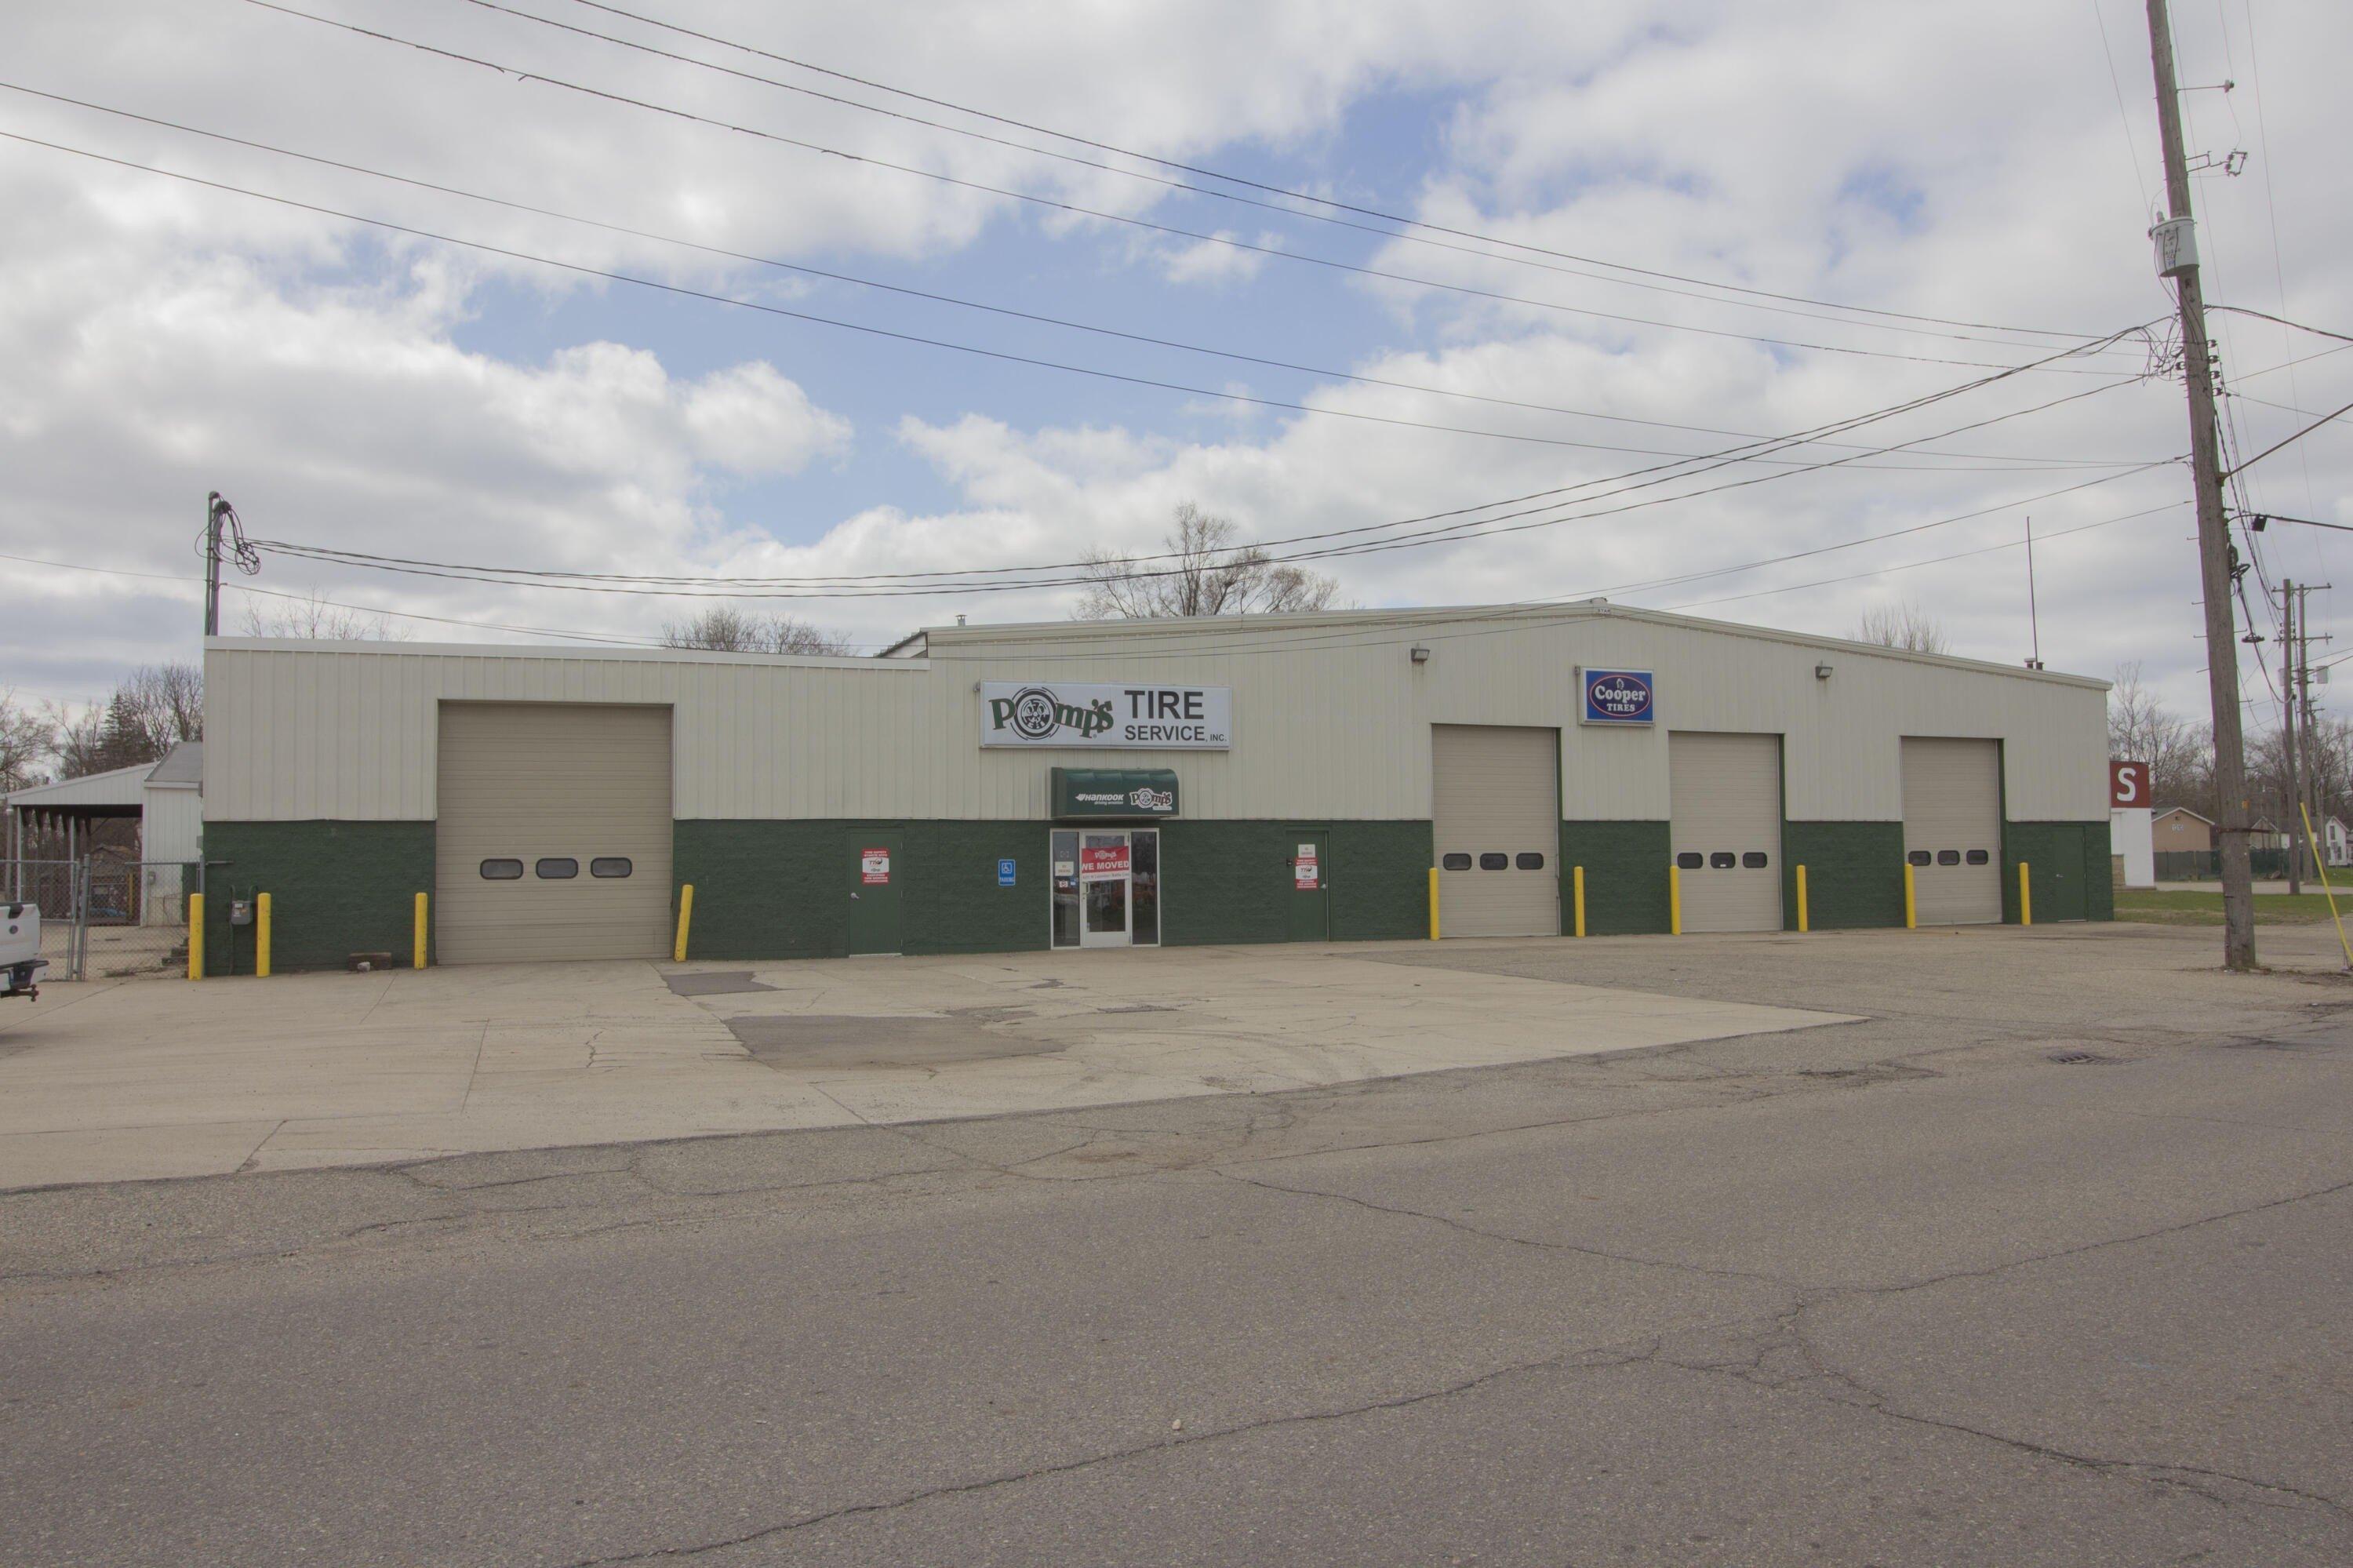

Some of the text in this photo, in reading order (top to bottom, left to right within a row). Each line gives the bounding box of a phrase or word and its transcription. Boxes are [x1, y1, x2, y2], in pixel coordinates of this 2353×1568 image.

[1595, 685, 1646, 704] Cooper
[988, 686, 1114, 740] Pomp's
[1124, 689, 1205, 720] TIRE
[1606, 704, 1635, 712] TIRES
[1209, 733, 1227, 742] INC.
[2116, 767, 2137, 802] S
[1096, 860, 1129, 870] MOVED
